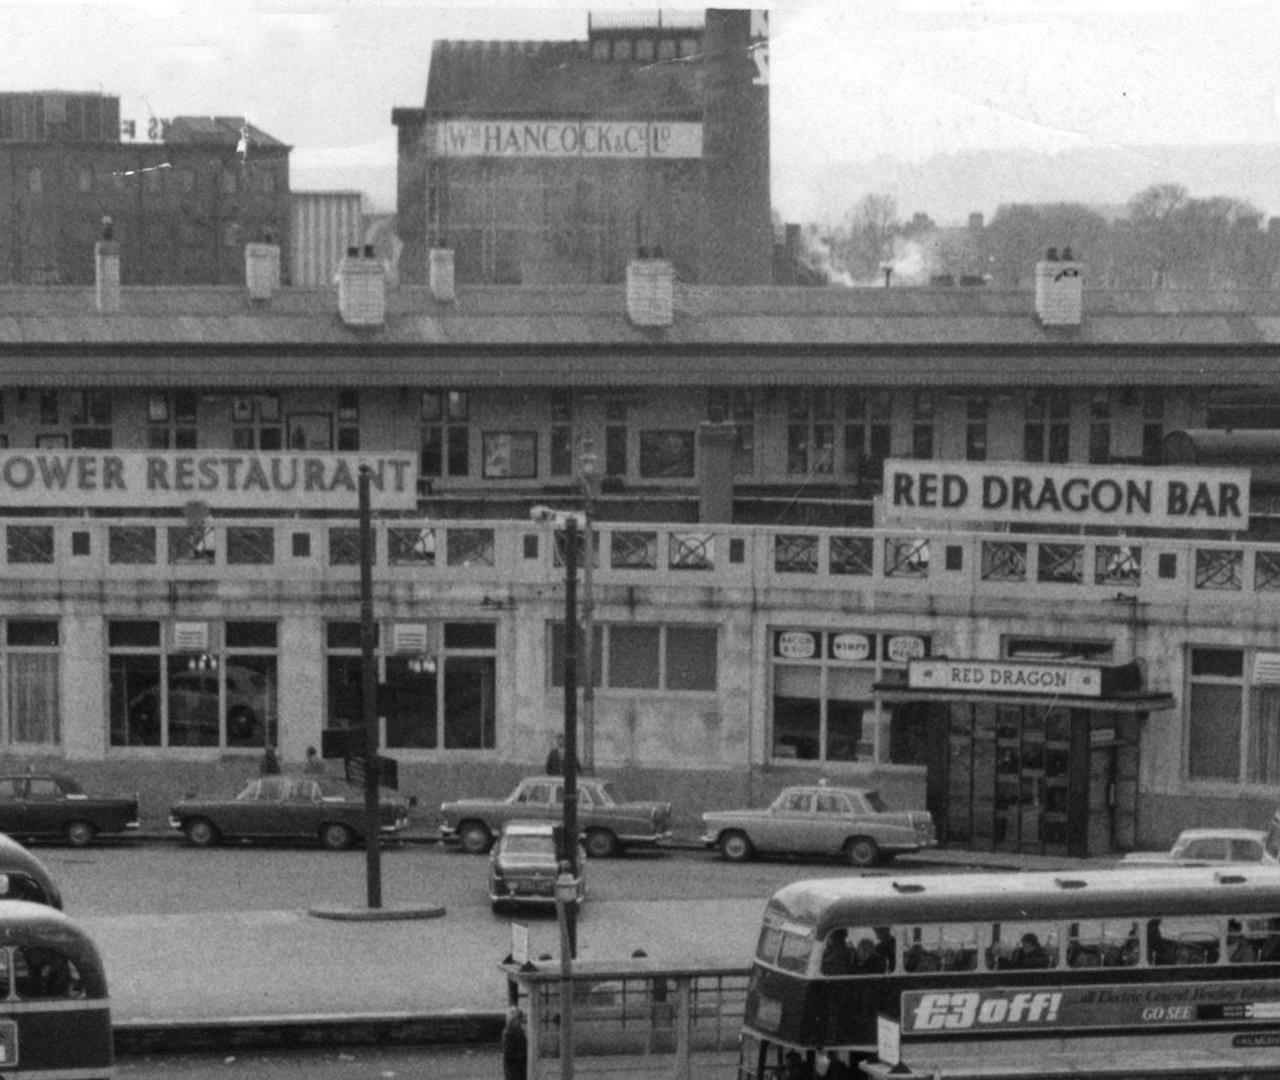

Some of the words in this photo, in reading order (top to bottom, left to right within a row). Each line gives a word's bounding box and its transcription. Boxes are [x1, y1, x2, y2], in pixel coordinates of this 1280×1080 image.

[484, 124, 612, 152] HANCOCK
[145, 456, 411, 492] RESTAURANT
[893, 472, 969, 508] RED
[981, 475, 1153, 514] DRAGON
[1166, 480, 1242, 517] BAR
[835, 643, 867, 652] WIMPY
[950, 668, 985, 685] RED
[989, 669, 1068, 688] DRAGON
[913, 993, 981, 1030] £3
[978, 993, 1063, 1023] off!
[1142, 1006, 1164, 1021] GO
[1167, 1005, 1193, 1020] SEE
